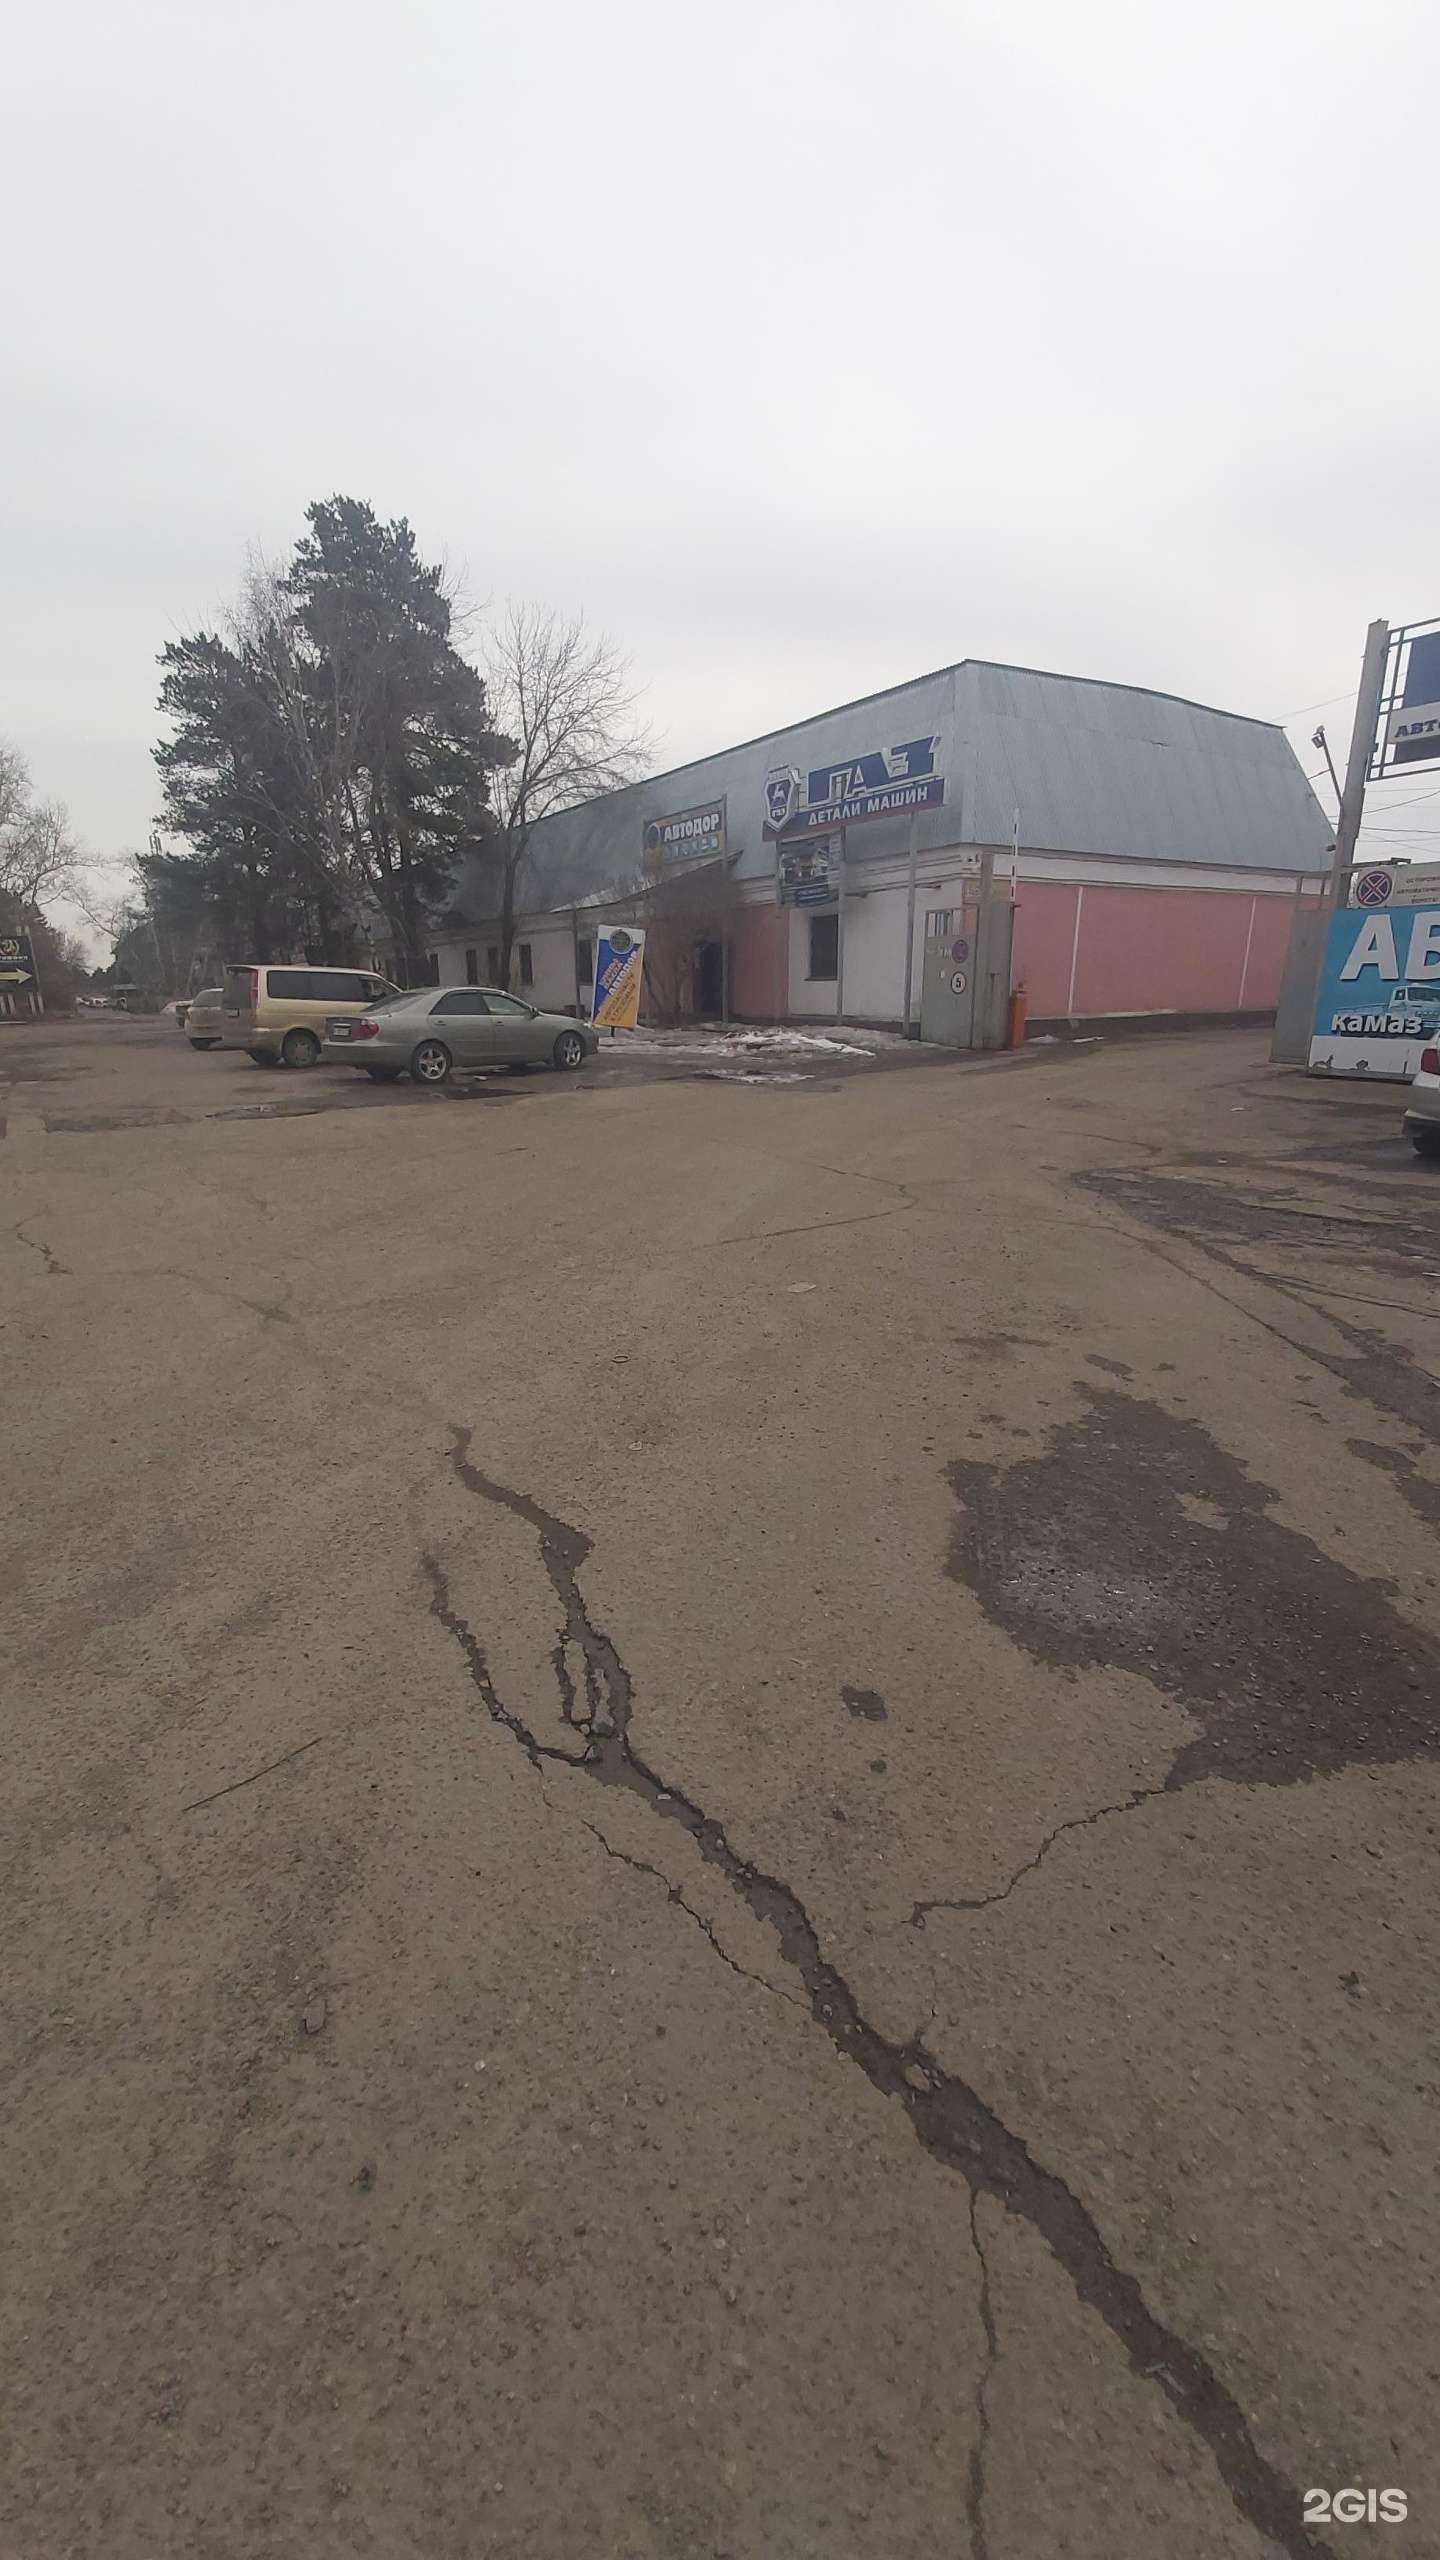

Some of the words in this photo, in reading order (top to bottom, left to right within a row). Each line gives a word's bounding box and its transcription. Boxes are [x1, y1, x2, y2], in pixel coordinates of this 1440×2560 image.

[1395, 719, 1440, 737] АВТ
[808, 801, 861, 826] ДЕТАЛИ
[867, 785, 928, 813] МАШИН
[664, 813, 719, 842] АВТОДОР
[955, 977, 961, 988] 5
